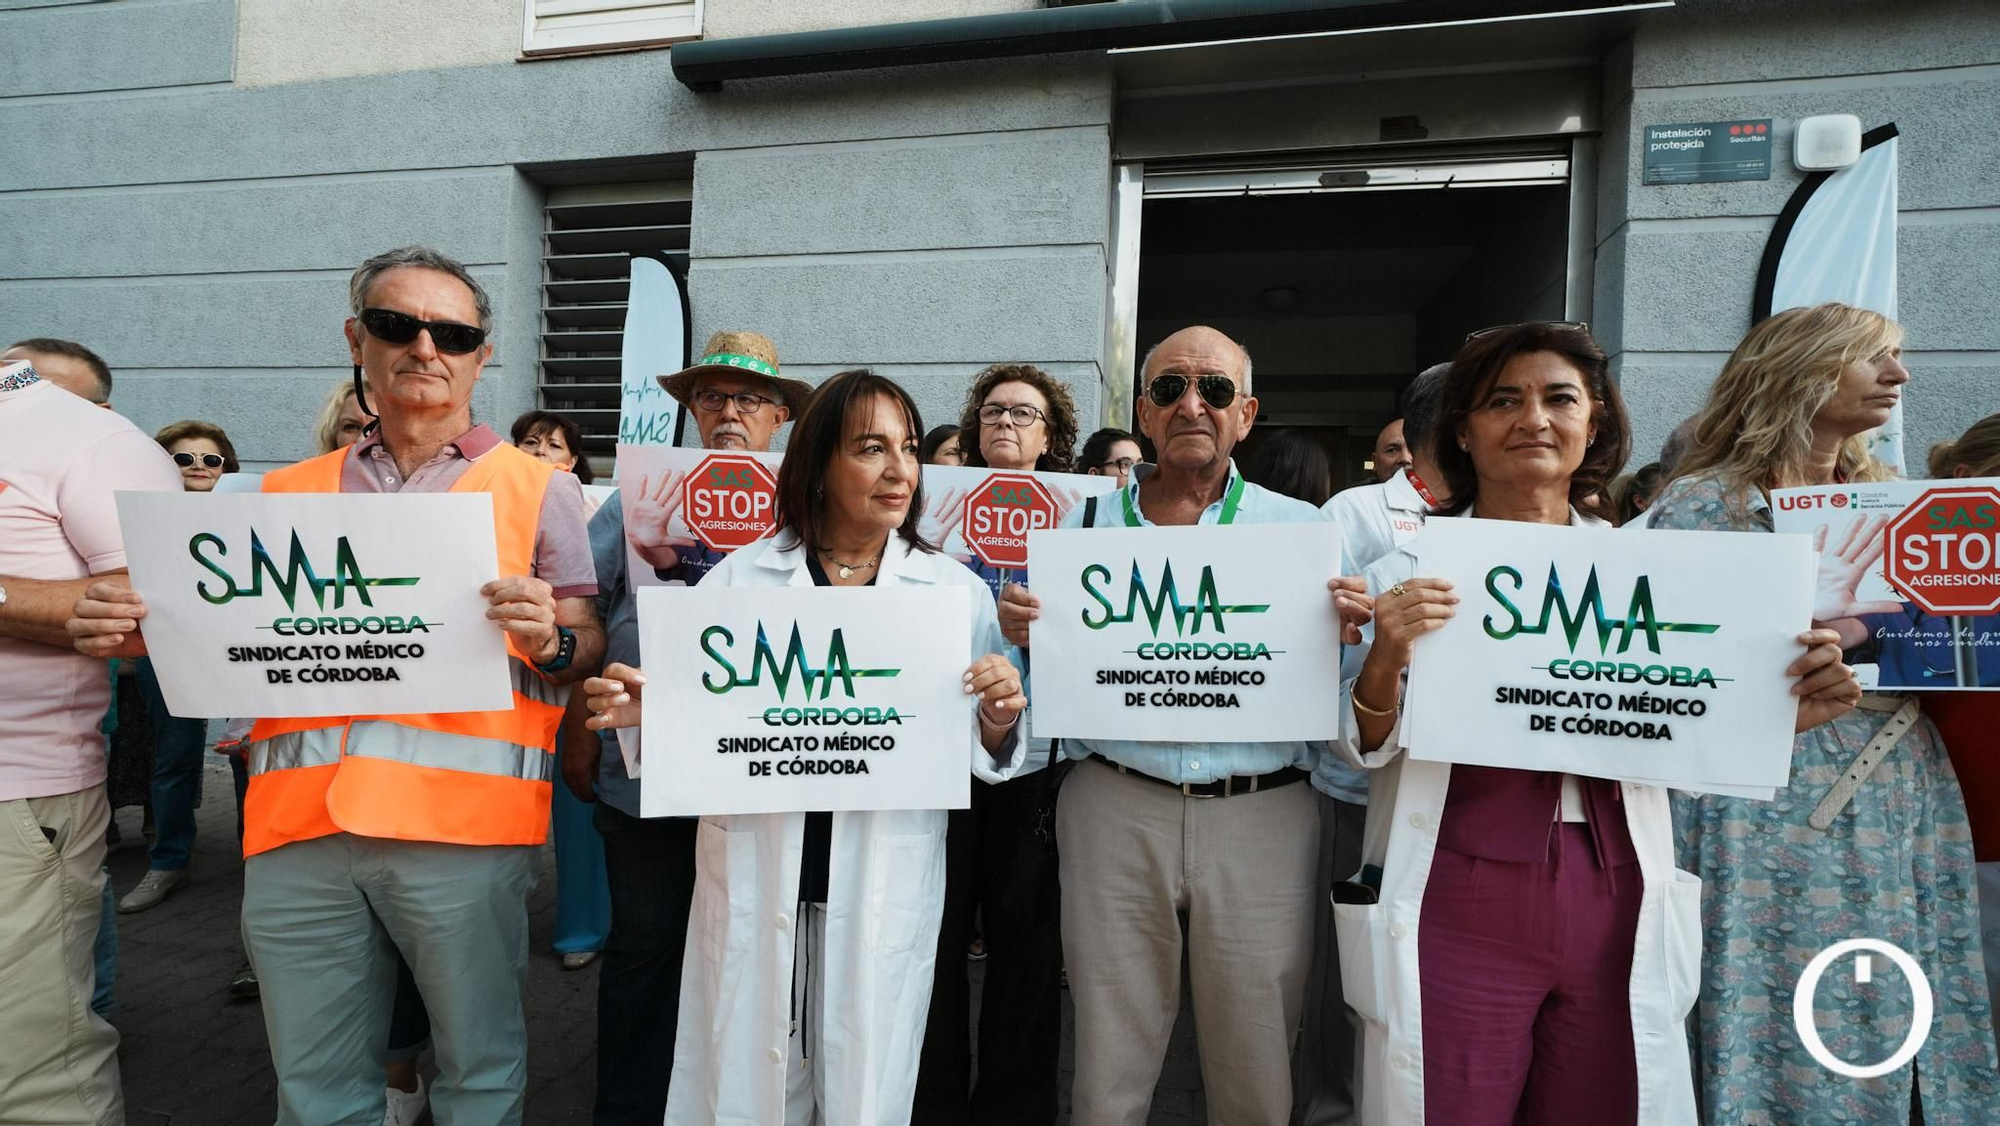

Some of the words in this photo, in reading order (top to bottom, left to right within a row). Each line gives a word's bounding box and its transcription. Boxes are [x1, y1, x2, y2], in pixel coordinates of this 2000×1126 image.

[1651, 127, 1712, 139] Instalación
[1729, 135, 1767, 144] Securitas
[1650, 139, 1705, 152] protegida
[709, 468, 754, 488] SAS
[694, 489, 771, 519] STOP
[991, 486, 1032, 506] SAS
[1779, 494, 1826, 511] UGT
[699, 520, 767, 531] AGRESIONES
[974, 506, 1047, 536] STOP
[1394, 520, 1418, 532] UGT
[1927, 504, 1996, 530] SAS
[189, 525, 421, 613] SMA
[1081, 557, 1270, 639] SMA
[1483, 560, 1721, 657] SMA
[273, 616, 430, 635] CORDOBA
[1876, 627, 1952, 639] Cuidemos
[1957, 627, 1975, 638] de
[228, 645, 340, 662] SINDICATO
[346, 640, 425, 659] MÉDICO
[701, 618, 901, 703] SMA
[1136, 643, 1272, 660] CORDOBA
[266, 669, 293, 684] DE
[297, 664, 400, 683] CÓRDOBA
[1096, 670, 1190, 685] SINDICATO
[1195, 666, 1265, 685] MÉDICO
[1549, 659, 1717, 689] CORDOBA
[1125, 692, 1145, 707] DE
[1150, 689, 1240, 708] CÓRDOBA
[1495, 686, 1612, 711] SINDICATO
[1618, 692, 1707, 717] MÉDICO
[763, 707, 902, 726] CORDOBA
[1530, 715, 1556, 732] DE
[1561, 713, 1672, 740] CÓRDOBA
[717, 736, 819, 753] SINDICATO
[824, 732, 895, 751] MÉDICO
[749, 761, 771, 776] DE
[776, 756, 869, 775] CÓRDOBA
